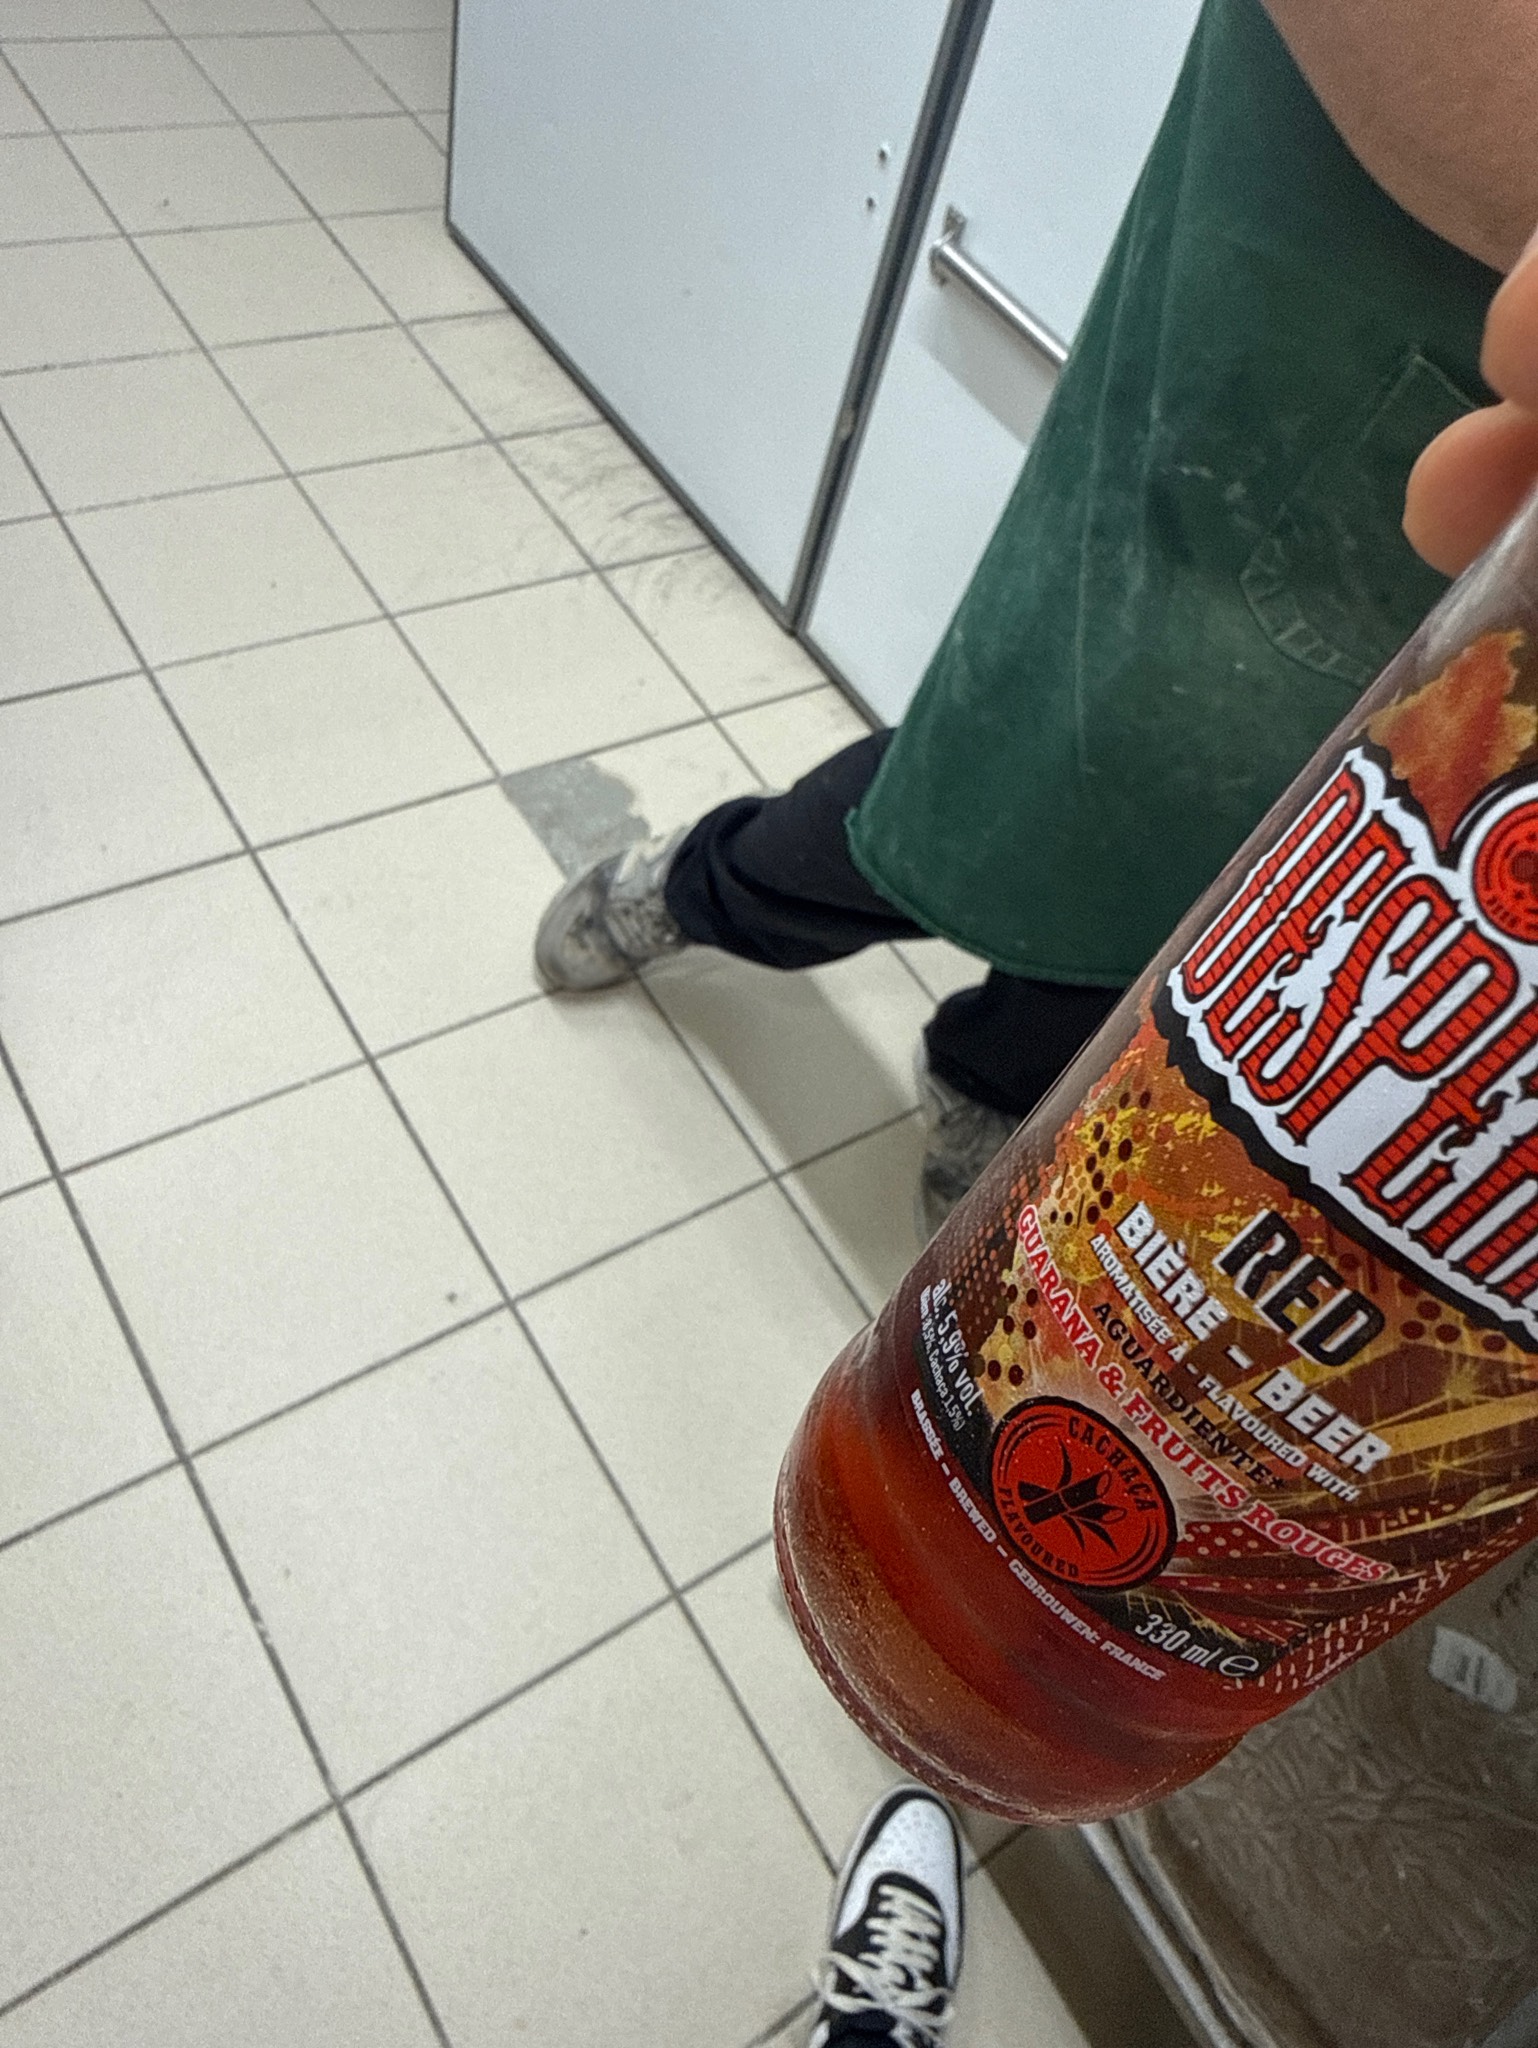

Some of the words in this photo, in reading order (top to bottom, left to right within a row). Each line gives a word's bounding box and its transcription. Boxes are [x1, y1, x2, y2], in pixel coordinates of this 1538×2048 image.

[1114, 1200, 1230, 1342] BIÈRE
[1252, 1366, 1393, 1474] BEER
[1212, 1208, 1386, 1368] RED
[928, 1348, 949, 1398] Cachaça
[938, 1309, 969, 1374] 5,9%
[954, 1367, 984, 1416] vol.
[1017, 1205, 1104, 1371] GUARANA
[1098, 1362, 1127, 1399] &
[1122, 1388, 1251, 1509] FRUITS
[1238, 1500, 1395, 1582] ROUGES
[1089, 1233, 1175, 1345] AROMATISÉE
[1198, 1374, 1310, 1469] FLAVOURED
[1304, 1462, 1363, 1502] WITH
[1068, 1416, 1158, 1511] CACHAÇA
[911, 1388, 945, 1461] BRASSÉE
[949, 1477, 997, 1543] BREWED
[1008, 1559, 1101, 1645] GEBROUWEN:
[1100, 1640, 1167, 1681] FRANCE
[999, 1487, 1079, 1578] FLAVOURED
[1135, 1614, 1191, 1651] 330
[1180, 1645, 1223, 1678] ml
